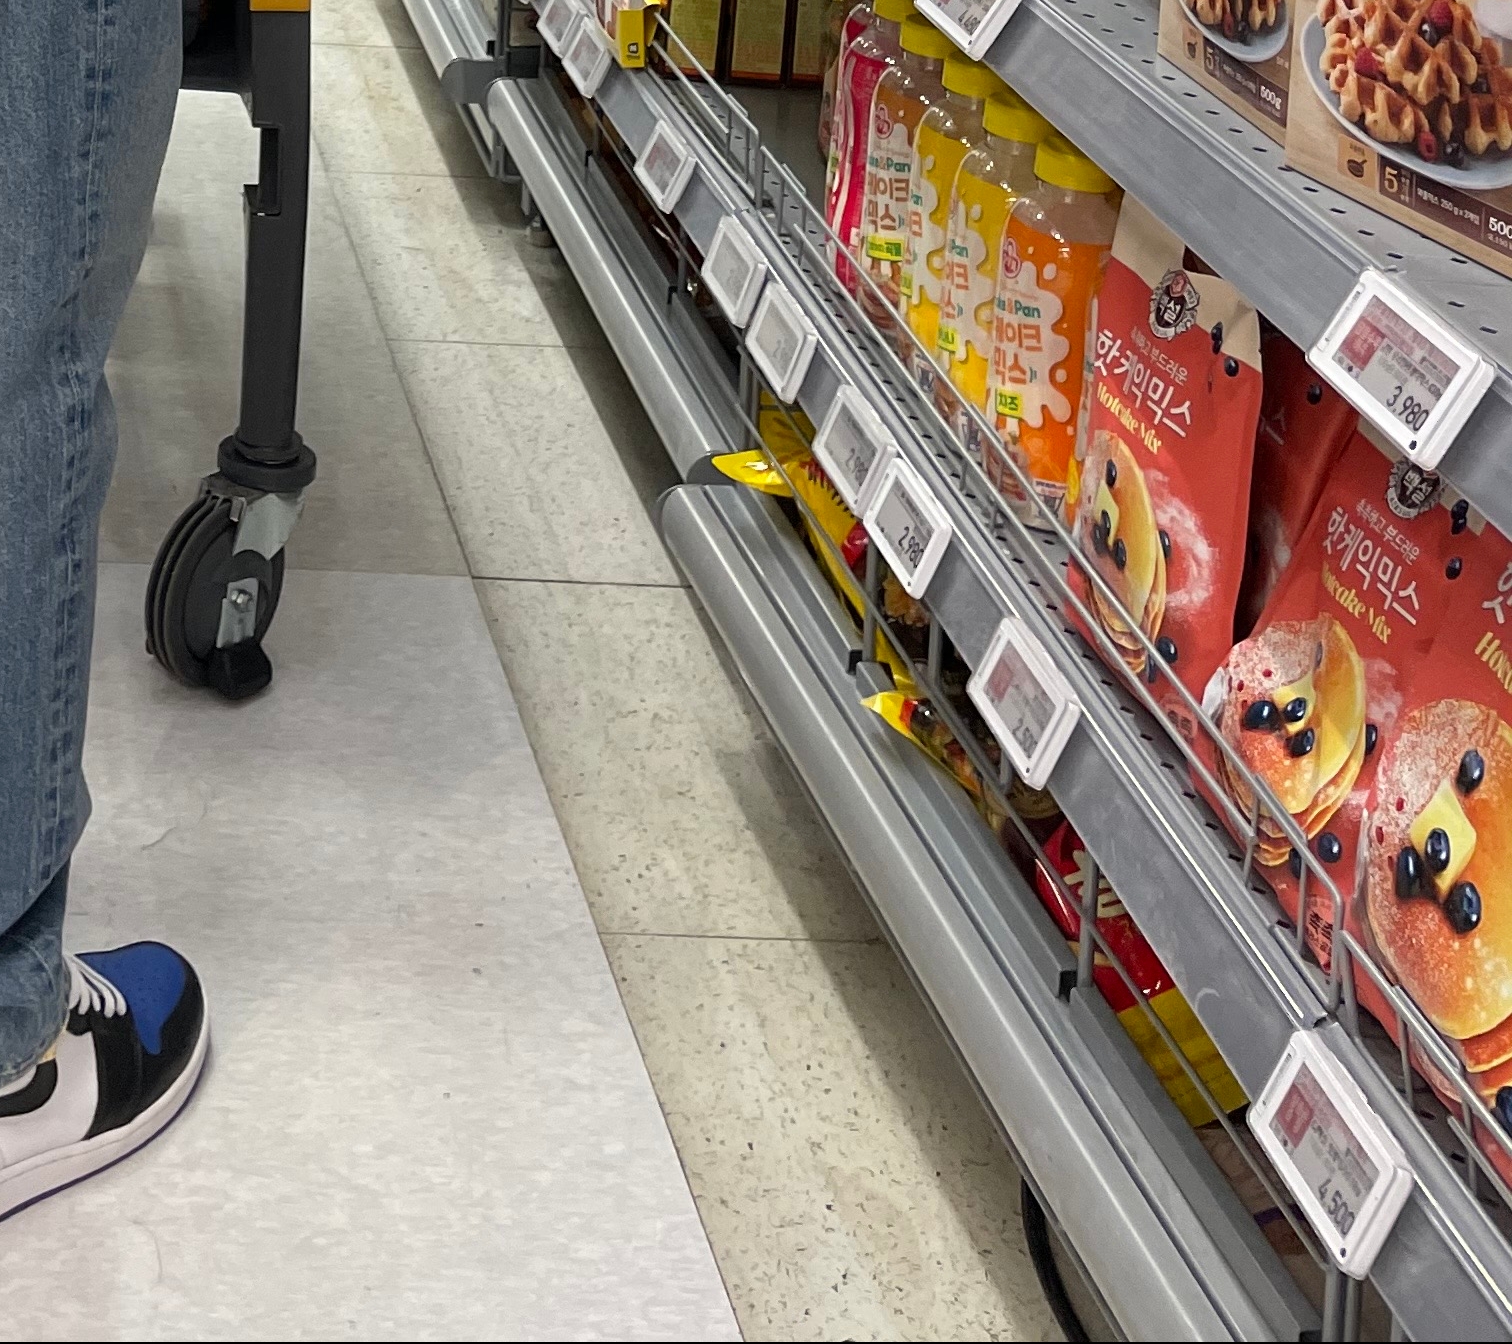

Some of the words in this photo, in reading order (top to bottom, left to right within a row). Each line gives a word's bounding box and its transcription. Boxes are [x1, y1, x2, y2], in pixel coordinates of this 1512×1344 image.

[1384, 165, 1399, 194] 5
[1150, 348, 1189, 386] 부드러운
[1386, 385, 1430, 432] 3,980
[1322, 505, 1421, 627] 핫케익믹스
[1384, 526, 1422, 567] 부드러운
[1366, 603, 1394, 645] Mix
